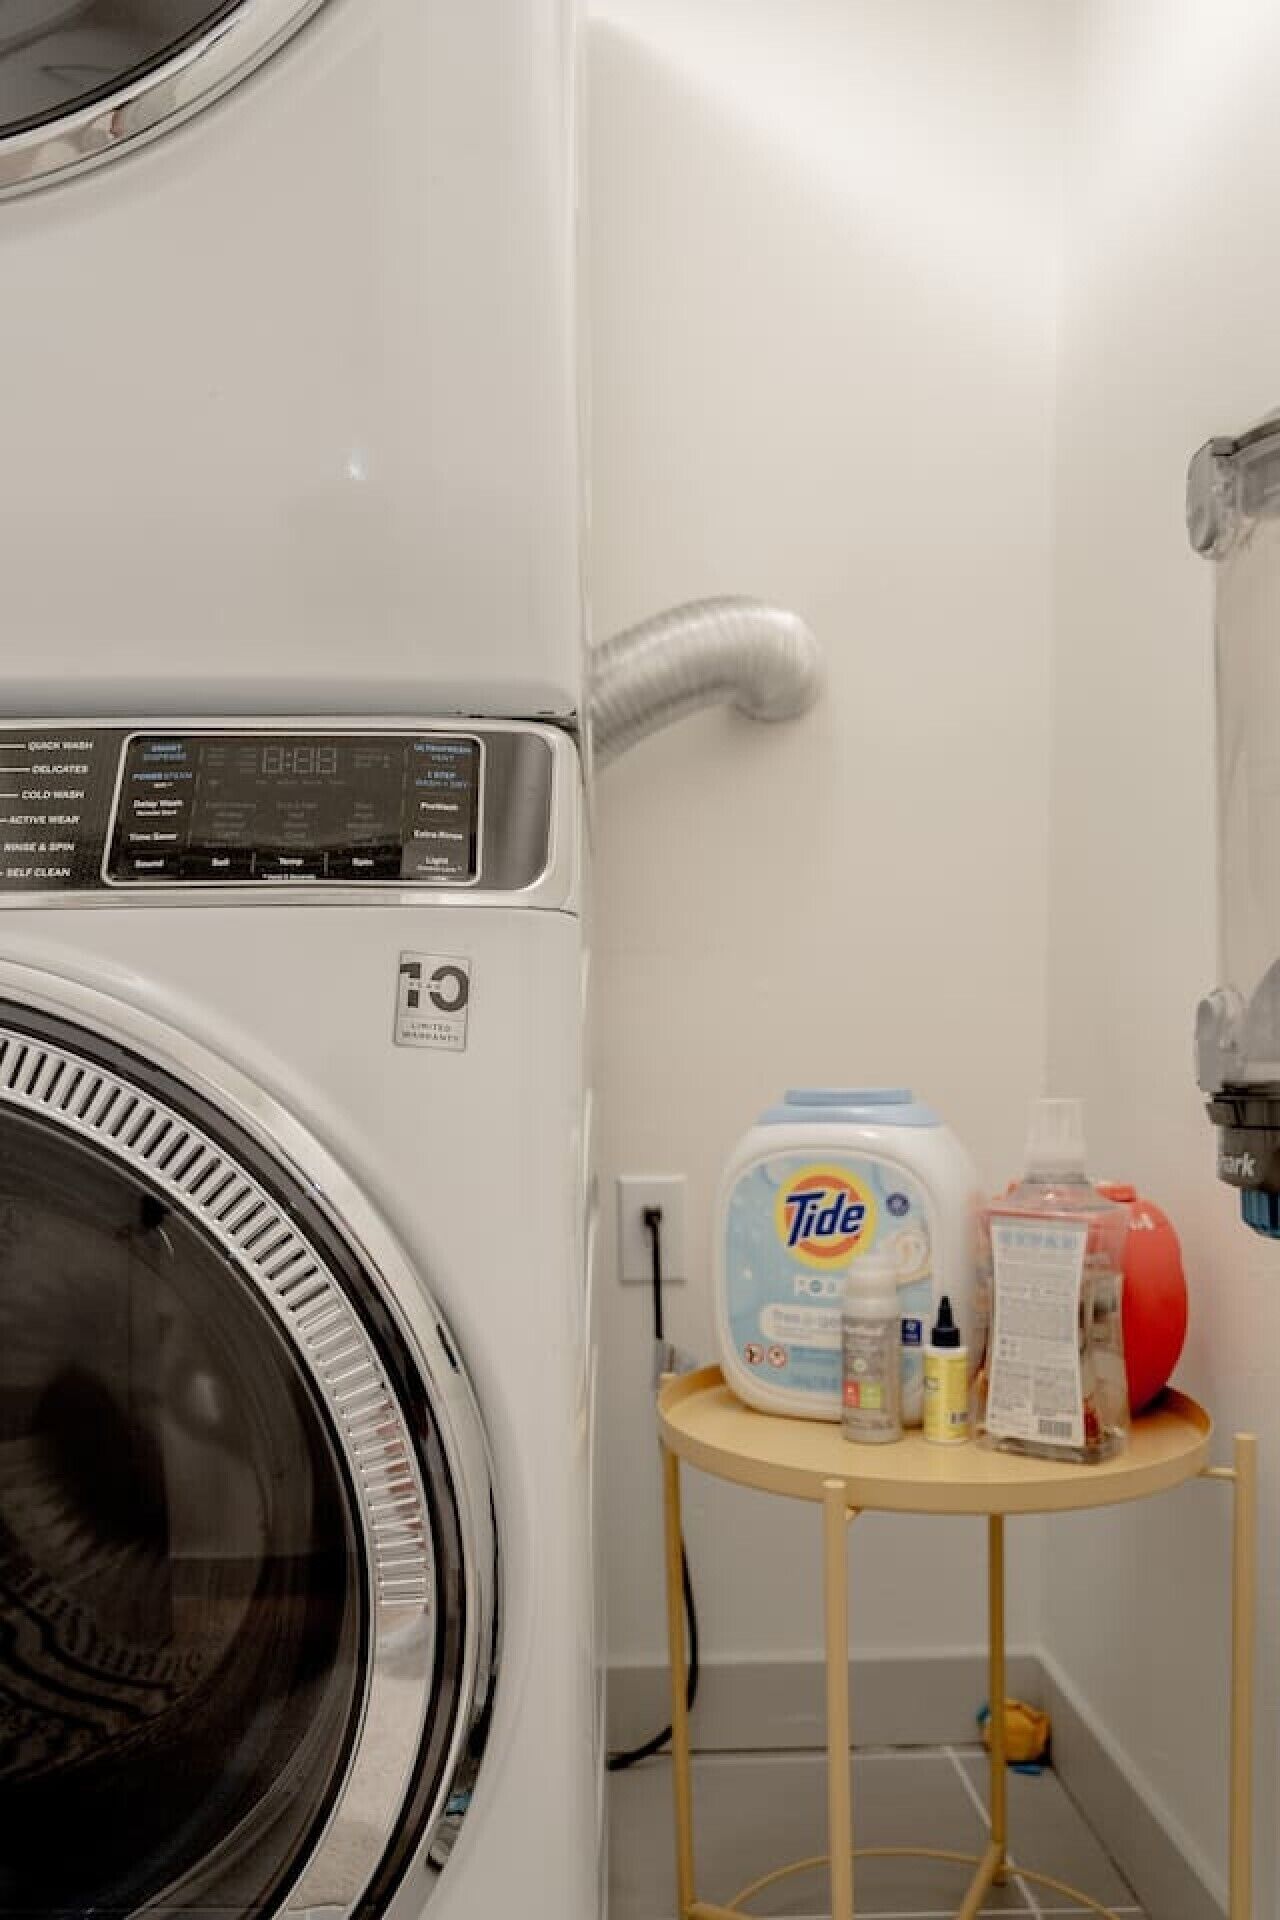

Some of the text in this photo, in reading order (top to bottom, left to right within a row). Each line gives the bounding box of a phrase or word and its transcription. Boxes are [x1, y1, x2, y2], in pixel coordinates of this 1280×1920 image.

[27, 741, 93, 751] QUICK WASH
[32, 765, 88, 774] DELICATES
[21, 789, 85, 799] COLD WASH
[10, 815, 80, 825] ACTIVE WEAR
[4, 842, 75, 852] RINSE & SPIN
[7, 867, 71, 877] SELF CLEAN
[399, 961, 470, 1013] 10
[1218, 1152, 1256, 1177] ark
[786, 1191, 866, 1248] Tide
